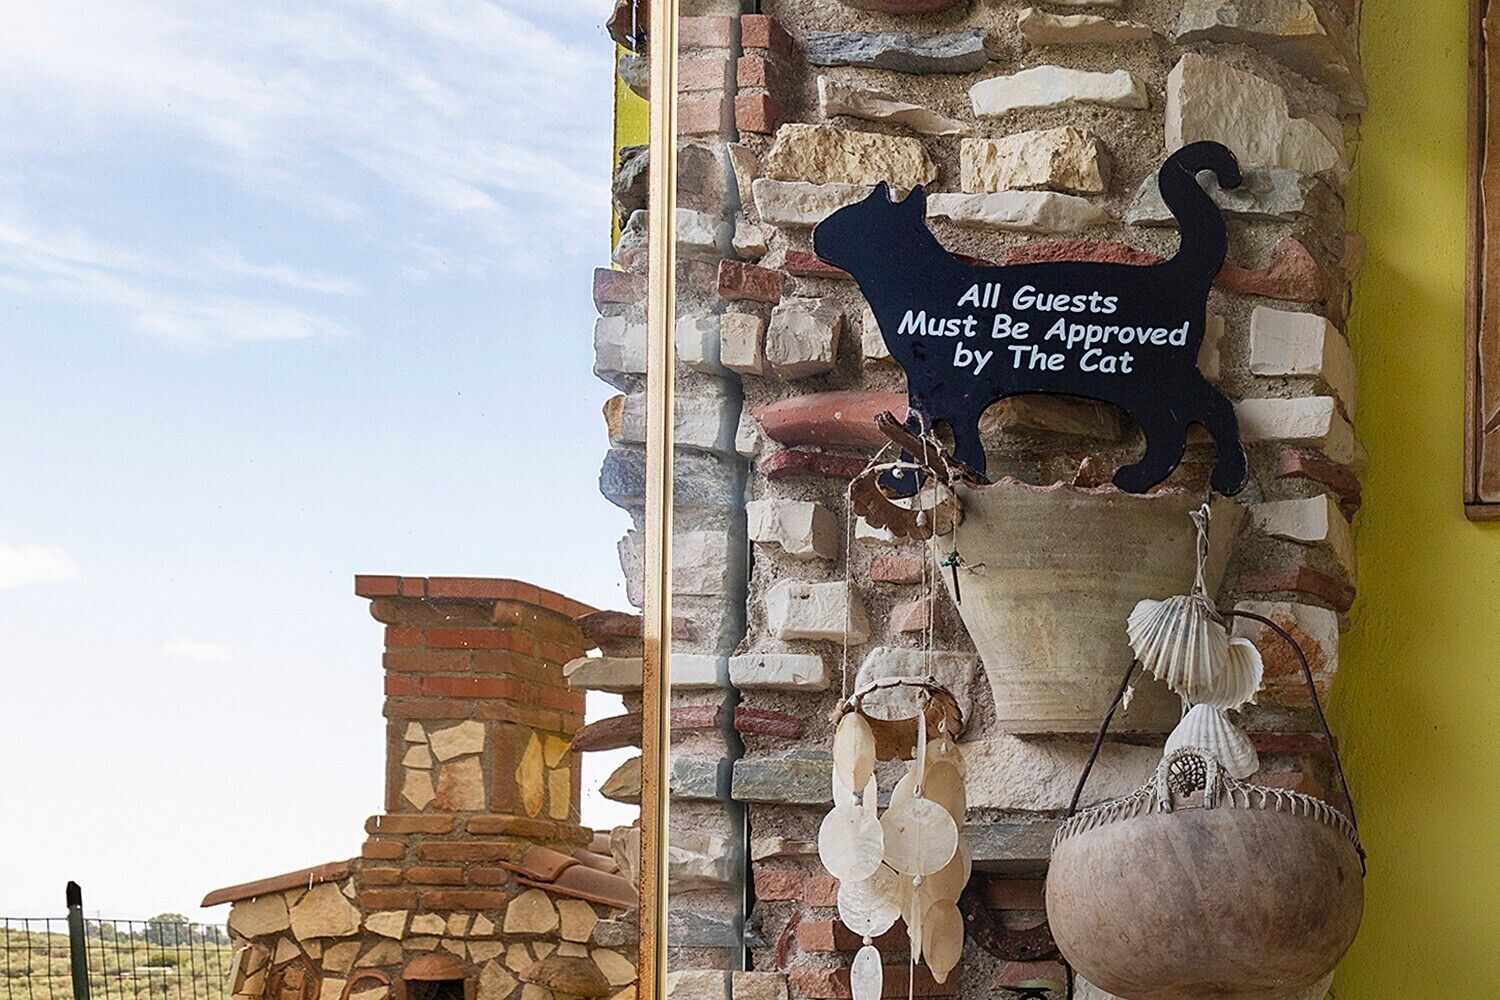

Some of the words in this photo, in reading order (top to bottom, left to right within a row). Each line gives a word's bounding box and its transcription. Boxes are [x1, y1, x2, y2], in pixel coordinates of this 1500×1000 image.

[956, 282, 1002, 309] All
[1012, 284, 1119, 314] Guests
[897, 309, 978, 339] Must
[991, 313, 1030, 340] Be
[1043, 318, 1190, 351] Approved
[953, 341, 994, 376] by
[1007, 344, 1066, 371] The
[1079, 348, 1134, 374] Cat
